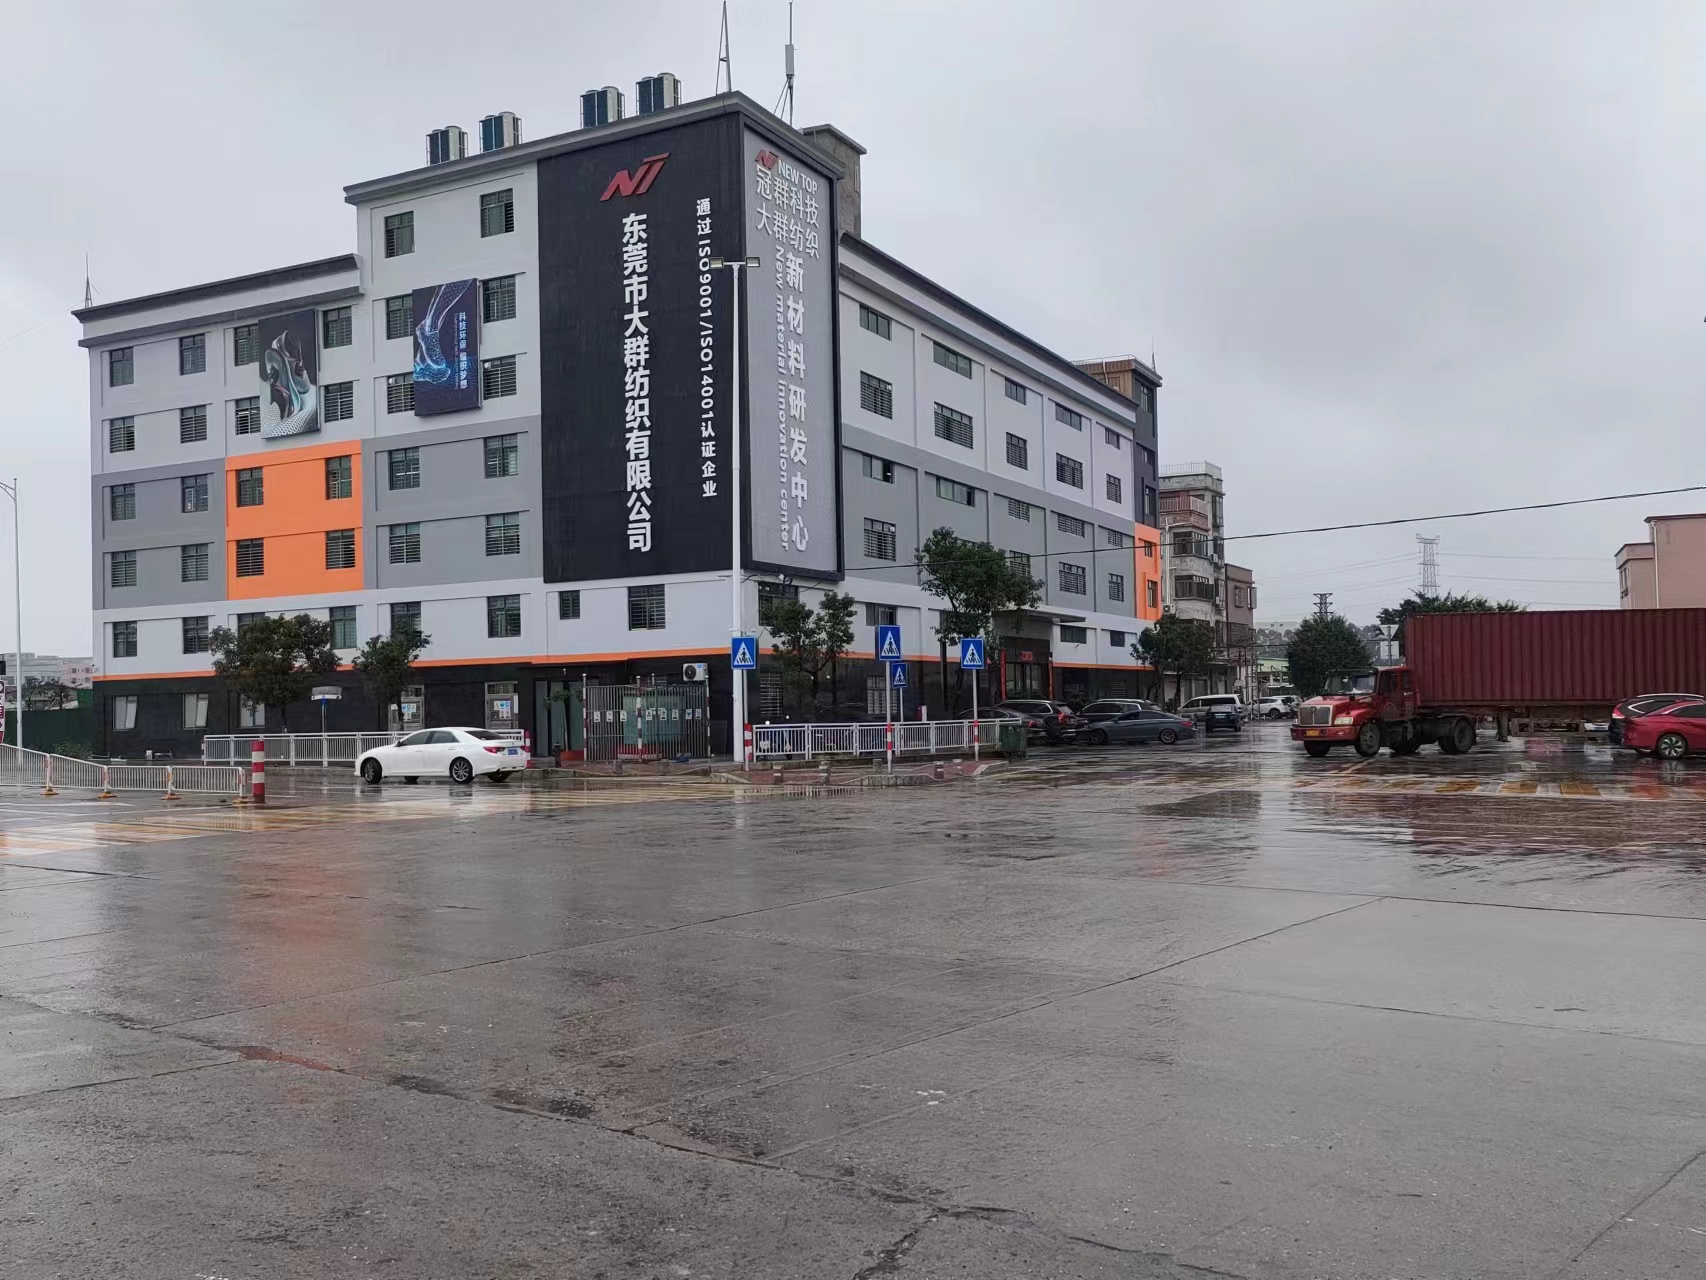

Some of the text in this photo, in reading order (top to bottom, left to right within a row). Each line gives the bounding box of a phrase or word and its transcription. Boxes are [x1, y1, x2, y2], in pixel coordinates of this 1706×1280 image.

[756, 164, 819, 228] 冠群科技
[756, 201, 819, 260] 大群纺织
[778, 159, 818, 195] NEW TOP
[621, 211, 653, 553] 东莞市大群纺织有限公司
[775, 244, 791, 552] New material innovation center
[785, 251, 809, 553] 新材料研发中心
